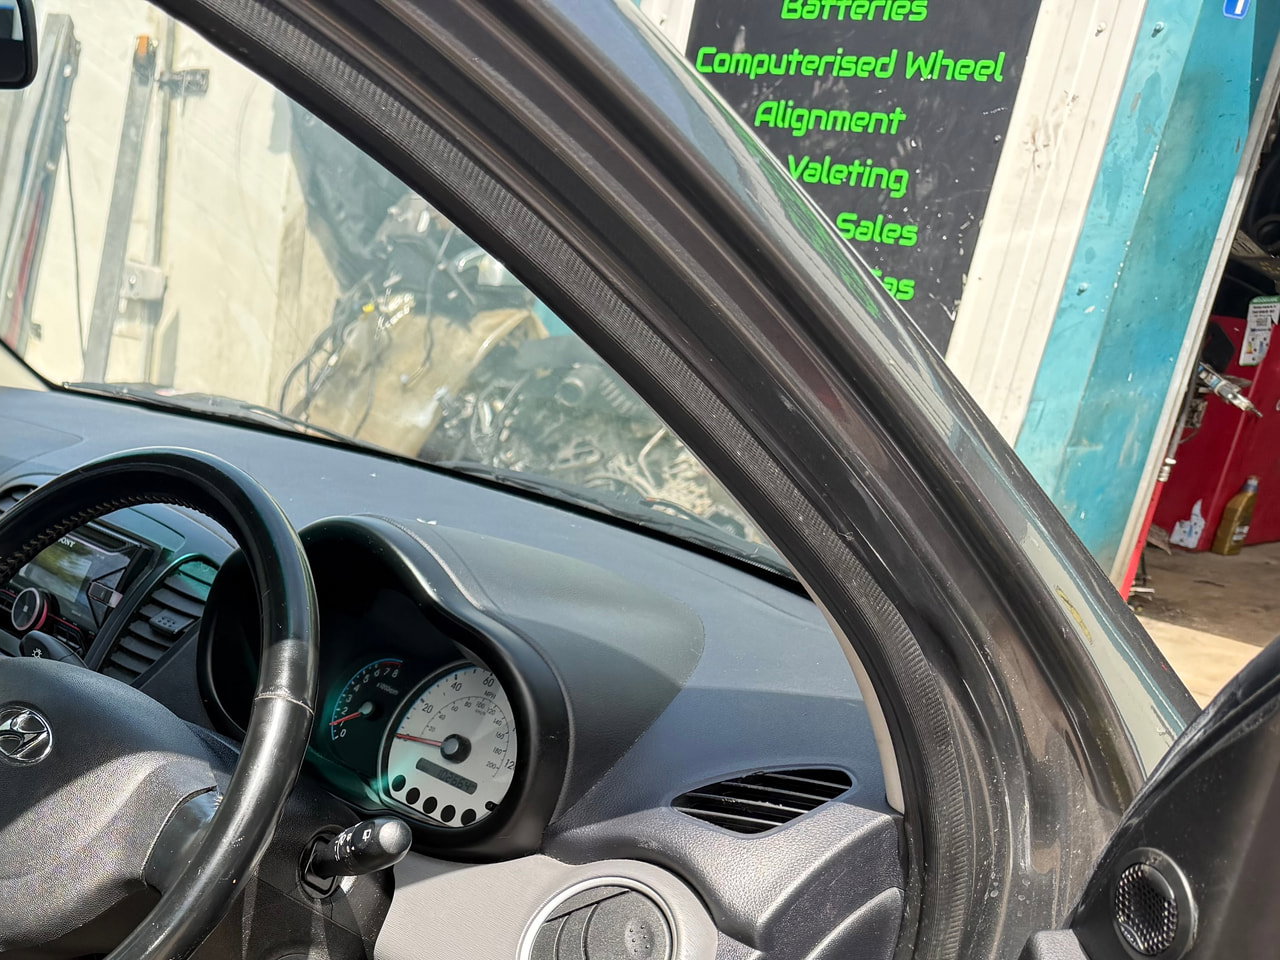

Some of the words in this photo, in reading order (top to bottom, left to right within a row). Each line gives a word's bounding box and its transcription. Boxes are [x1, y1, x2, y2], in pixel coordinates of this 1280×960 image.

[780, 0, 928, 21] Batteries
[695, 46, 898, 80] Computerised
[905, 49, 1006, 82] Wheel
[754, 100, 907, 137] Alignment
[787, 154, 909, 199] Valeting
[836, 212, 919, 247] Sales
[450, 682, 462, 692] 40
[482, 676, 495, 688] 60
[340, 728, 347, 738] 0
[504, 759, 516, 770] 12
